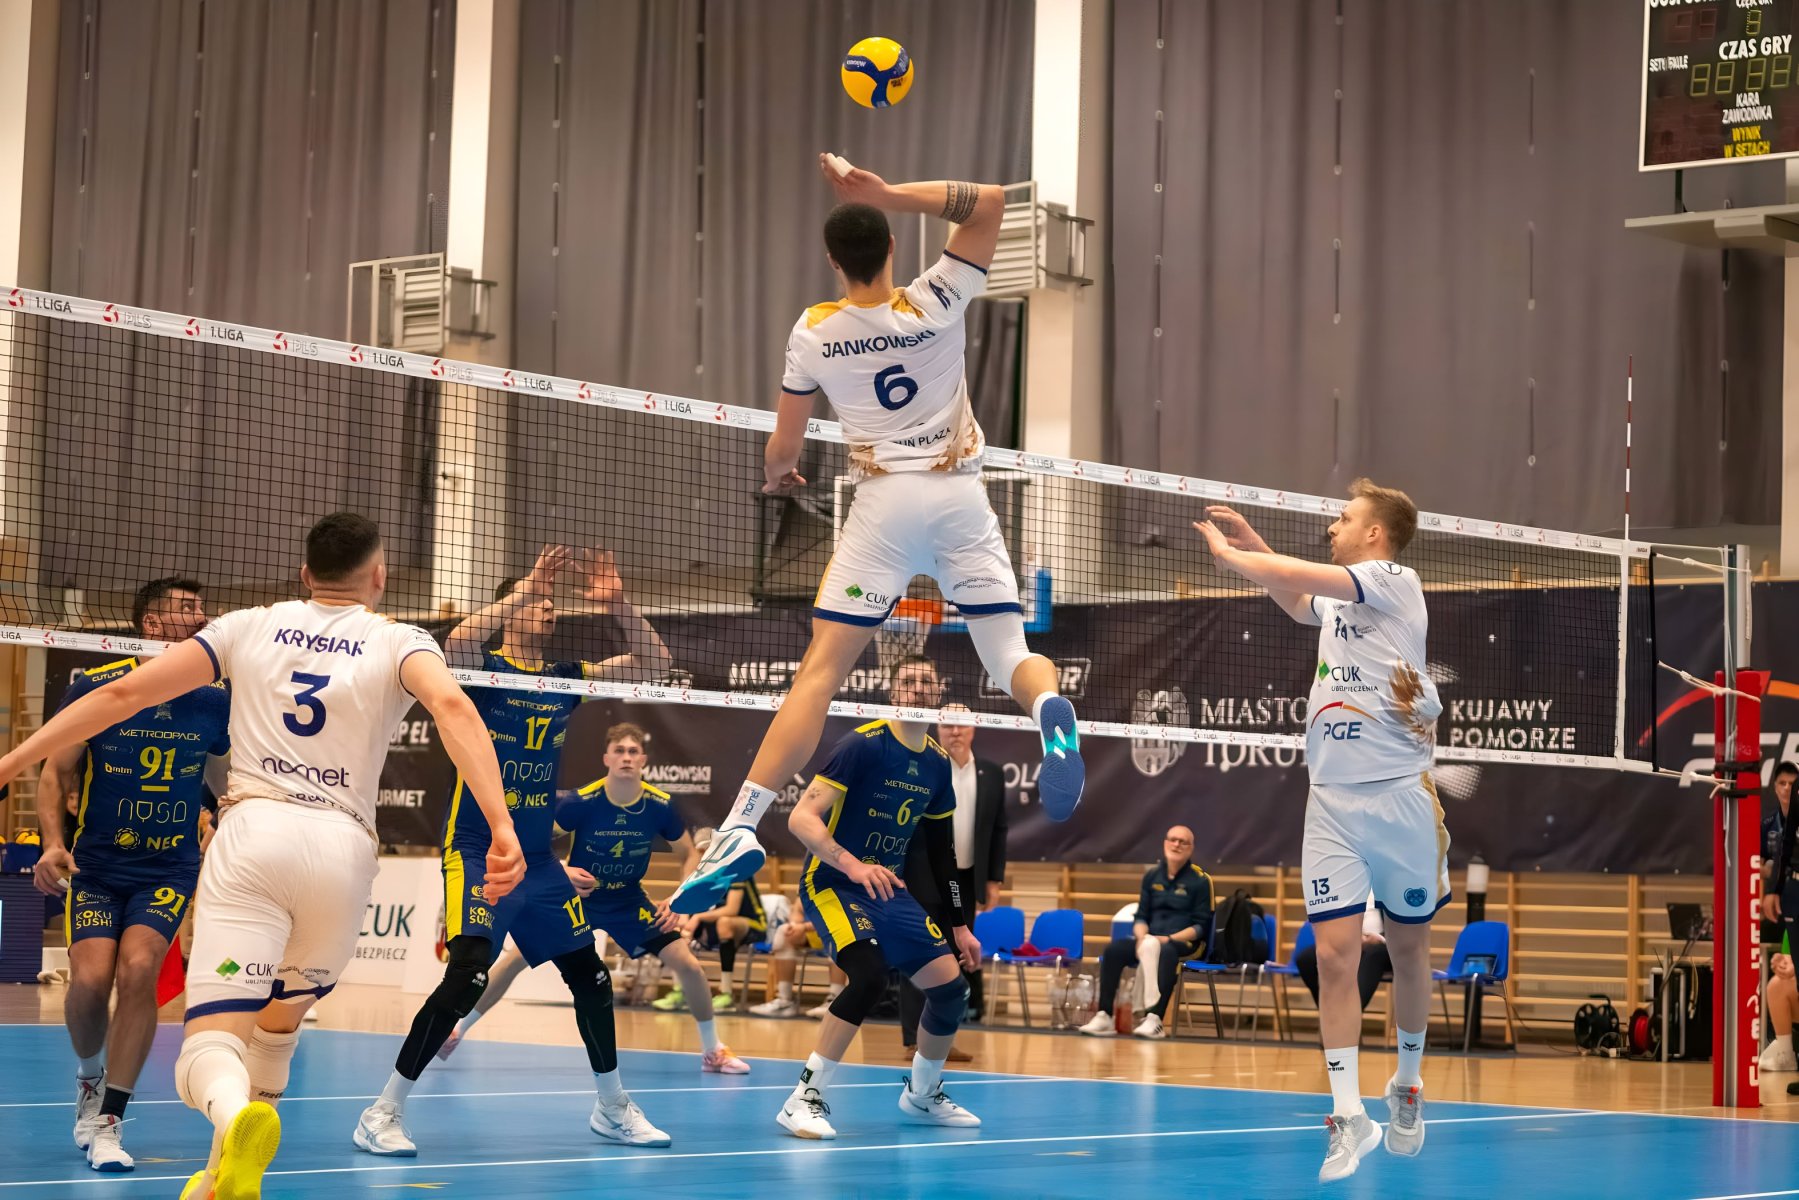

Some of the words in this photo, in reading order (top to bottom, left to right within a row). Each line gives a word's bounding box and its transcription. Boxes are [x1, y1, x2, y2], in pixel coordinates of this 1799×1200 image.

[1719, 38, 1757, 60] CZAS
[1760, 34, 1792, 55] GRY
[1736, 92, 1760, 107] KARA
[1722, 105, 1772, 124] ZAWODNIKA
[1732, 126, 1761, 141] WYNIK
[1736, 141, 1770, 157] SETACH
[822, 329, 936, 358] JANKOWSKI
[873, 364, 919, 411] 6
[866, 592, 889, 606] CUK
[274, 628, 366, 657] KRYSIAK
[92, 669, 125, 682] CUTLINE
[1331, 666, 1362, 683] CUK
[282, 670, 331, 737] 3
[1200, 697, 1308, 725] MIASTO
[1450, 699, 1553, 722] KUJAWY
[524, 716, 552, 750] 17
[1450, 727, 1577, 750] POMORZE
[140, 745, 177, 780] 91
[260, 757, 350, 788] nomet
[524, 793, 549, 807] NEC
[897, 798, 915, 826] 6
[609, 840, 625, 858] 4
[1312, 877, 1330, 896] 13
[150, 887, 185, 917] 91
[563, 894, 586, 928] 17
[76, 909, 112, 921] KOKU
[925, 915, 942, 939] 6
[245, 963, 274, 977] CUK
